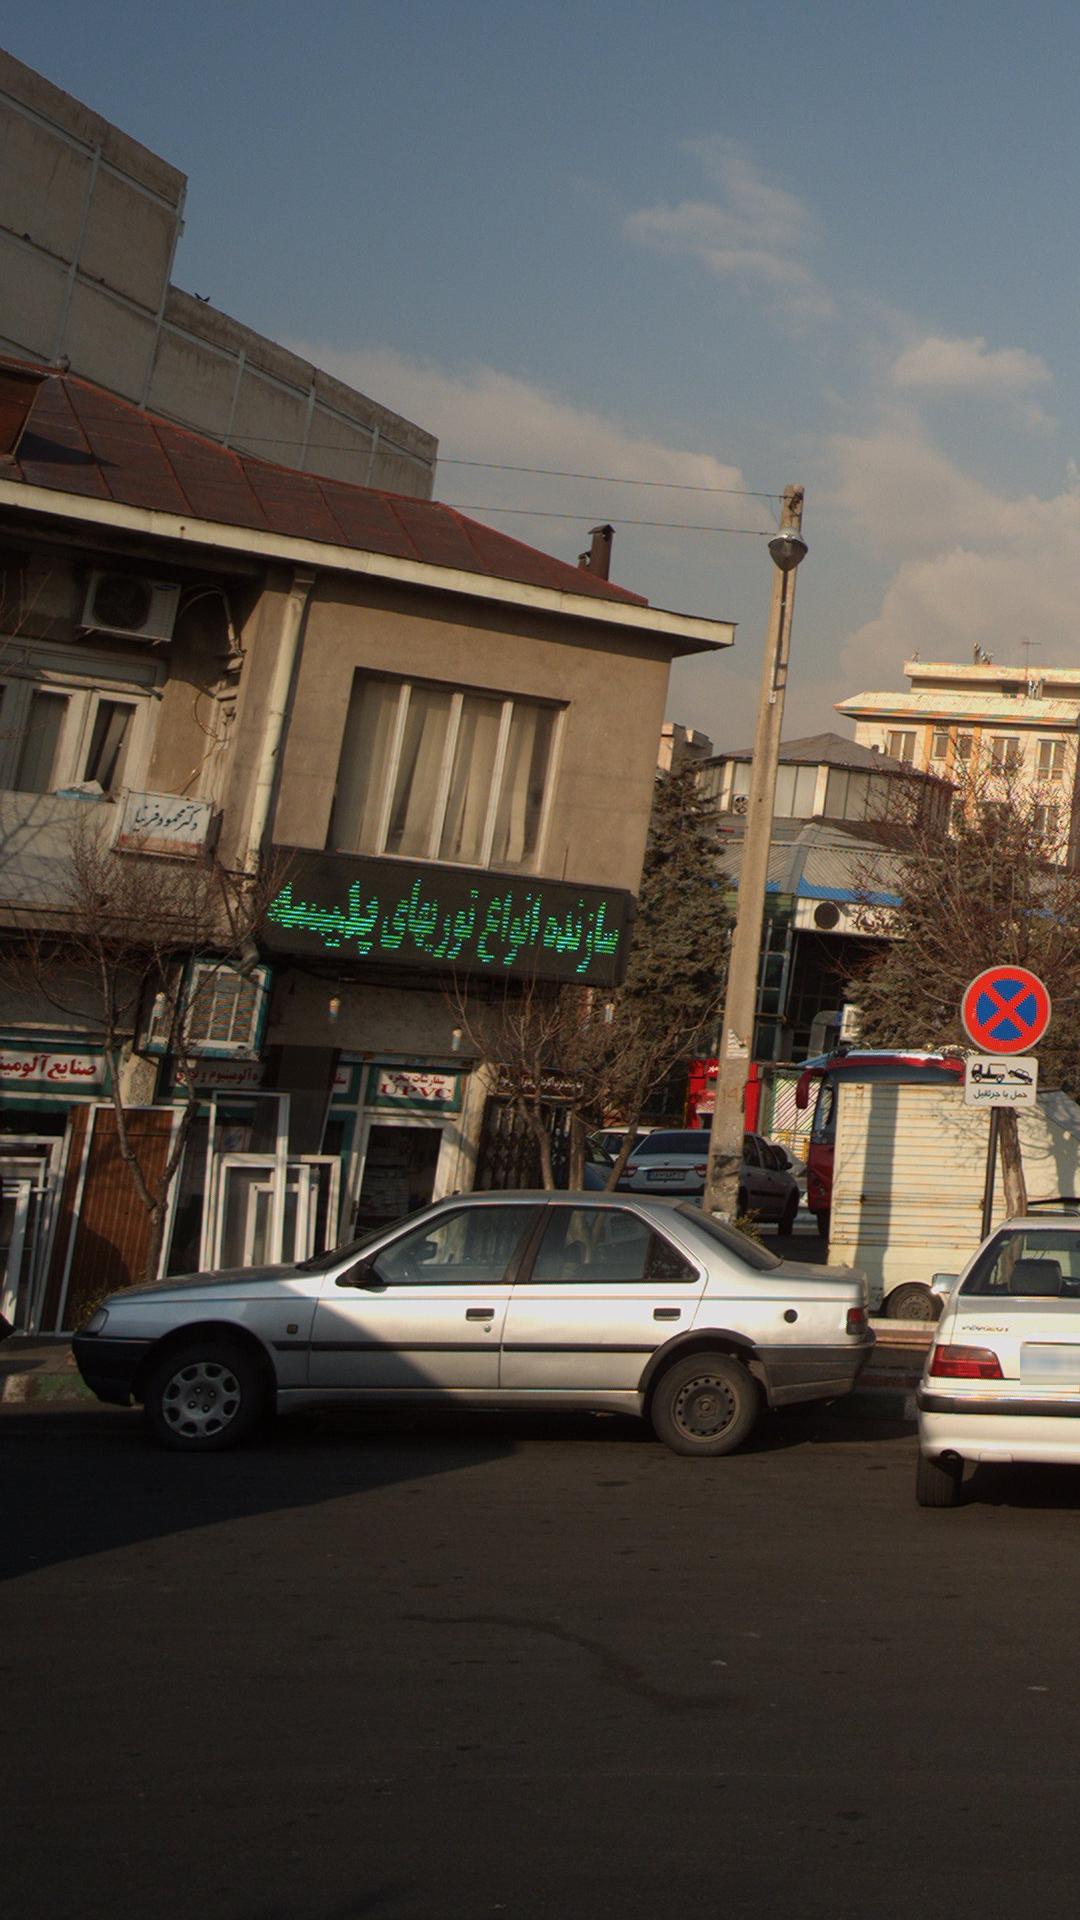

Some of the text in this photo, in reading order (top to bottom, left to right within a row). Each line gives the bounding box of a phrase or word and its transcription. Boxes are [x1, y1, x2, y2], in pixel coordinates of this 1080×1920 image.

[174, 806, 202, 831] دکتر
[477, 889, 542, 965] انواع
[544, 899, 619, 973] سازنده
[47, 1058, 97, 1079] صنایع
[381, 1084, 452, 1099] UPVC
[974, 1090, 1001, 1101] جرثقیل
[1010, 1091, 1027, 1100] حمل
